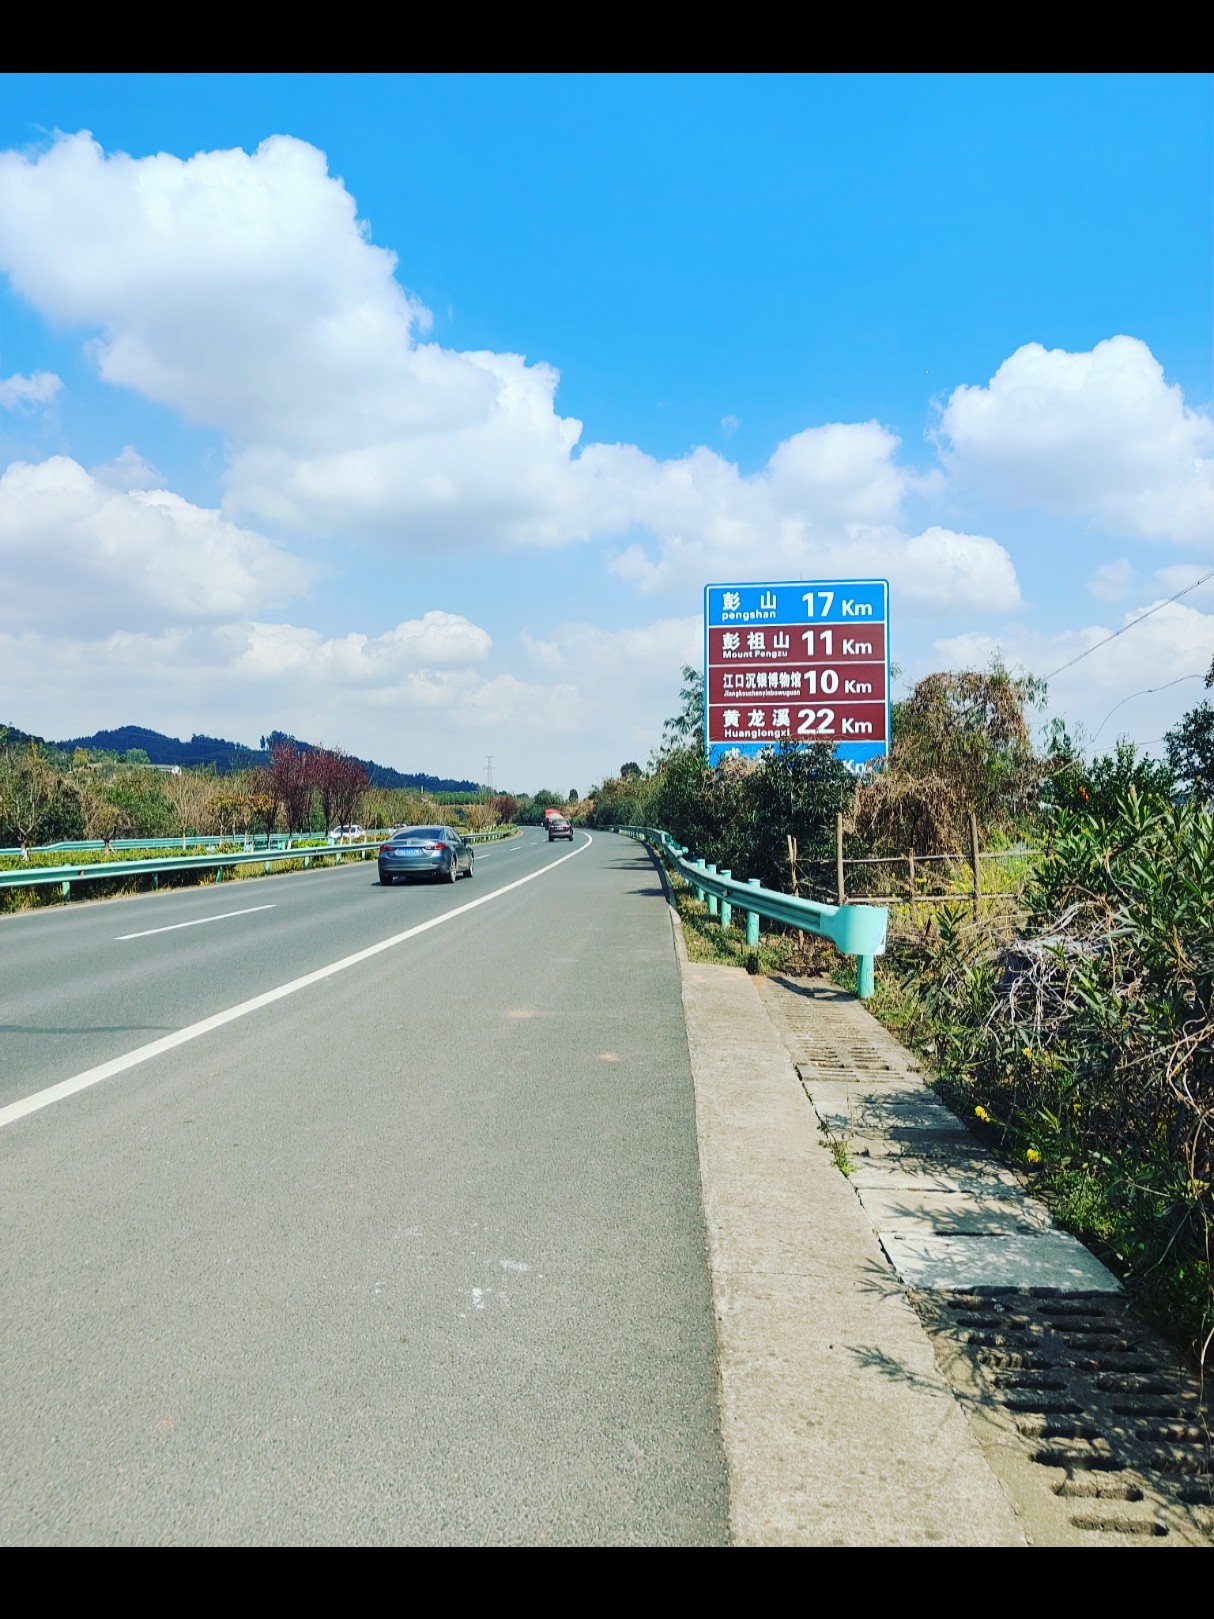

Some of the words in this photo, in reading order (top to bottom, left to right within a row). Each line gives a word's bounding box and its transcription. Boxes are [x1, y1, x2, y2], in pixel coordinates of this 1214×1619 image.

[722, 609, 776, 622] pengshan
[723, 591, 777, 611] 彭山
[802, 592, 834, 617] 17
[842, 600, 873, 616] Km
[722, 631, 790, 650] 彭祖山
[801, 630, 833, 656] 11
[843, 639, 873, 655] Km
[723, 650, 753, 659] Mount
[754, 650, 788, 659] Pengzu
[723, 671, 802, 689] 江口沉银博物馆
[804, 669, 839, 695] 10
[845, 680, 872, 694] Km
[723, 708, 790, 728] 黄龙溪
[797, 708, 835, 735] 22
[842, 718, 873, 734] Km
[724, 728, 790, 739] Huanglongxi
